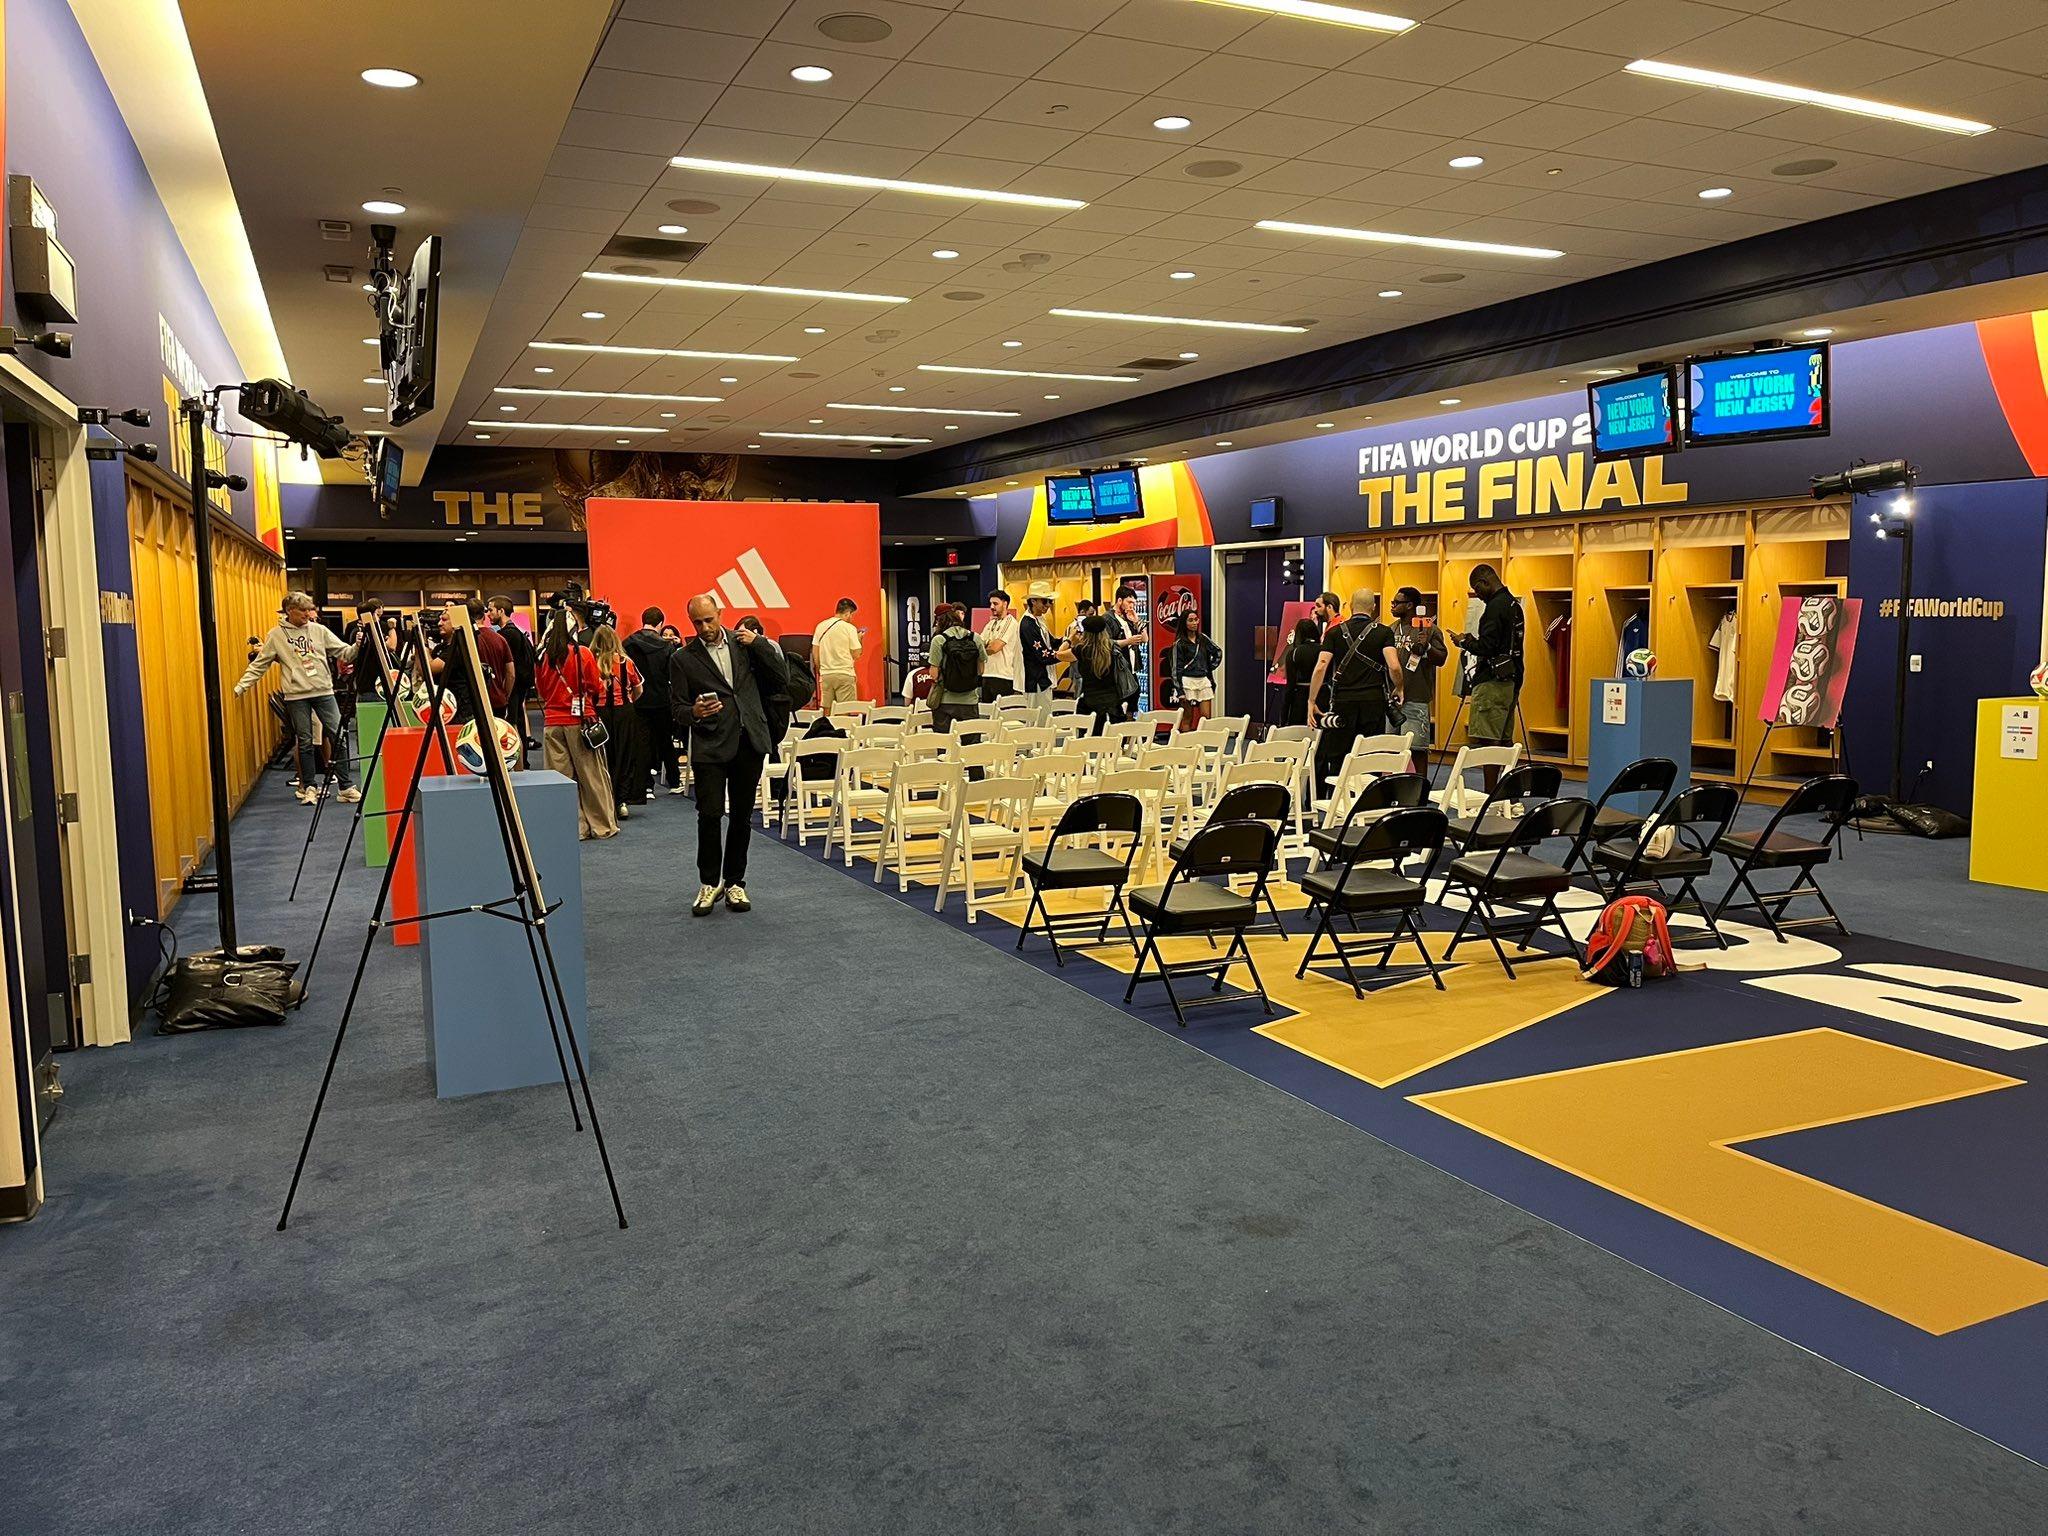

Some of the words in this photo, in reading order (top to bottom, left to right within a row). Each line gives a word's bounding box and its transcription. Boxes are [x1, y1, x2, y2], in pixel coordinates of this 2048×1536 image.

[1715, 379, 1750, 401] NEW
[1753, 373, 1795, 397] YORK
[1730, 370, 1768, 379] WELCOME
[1607, 401, 1628, 420] NEW
[1629, 395, 1654, 416] YORK
[1715, 400, 1745, 418] NEW
[1746, 393, 1795, 414] JERSEY
[1608, 419, 1626, 435] NEW
[1627, 414, 1655, 433] JERSEY
[1358, 441, 1408, 475] FIFA
[1409, 427, 1504, 467] WORLD
[1507, 417, 1567, 454] CUP
[1358, 466, 1466, 528] THE
[1478, 451, 1688, 519] FINAL
[432, 490, 544, 526] THE
[1879, 597, 2004, 620] #FFAWorldCup
